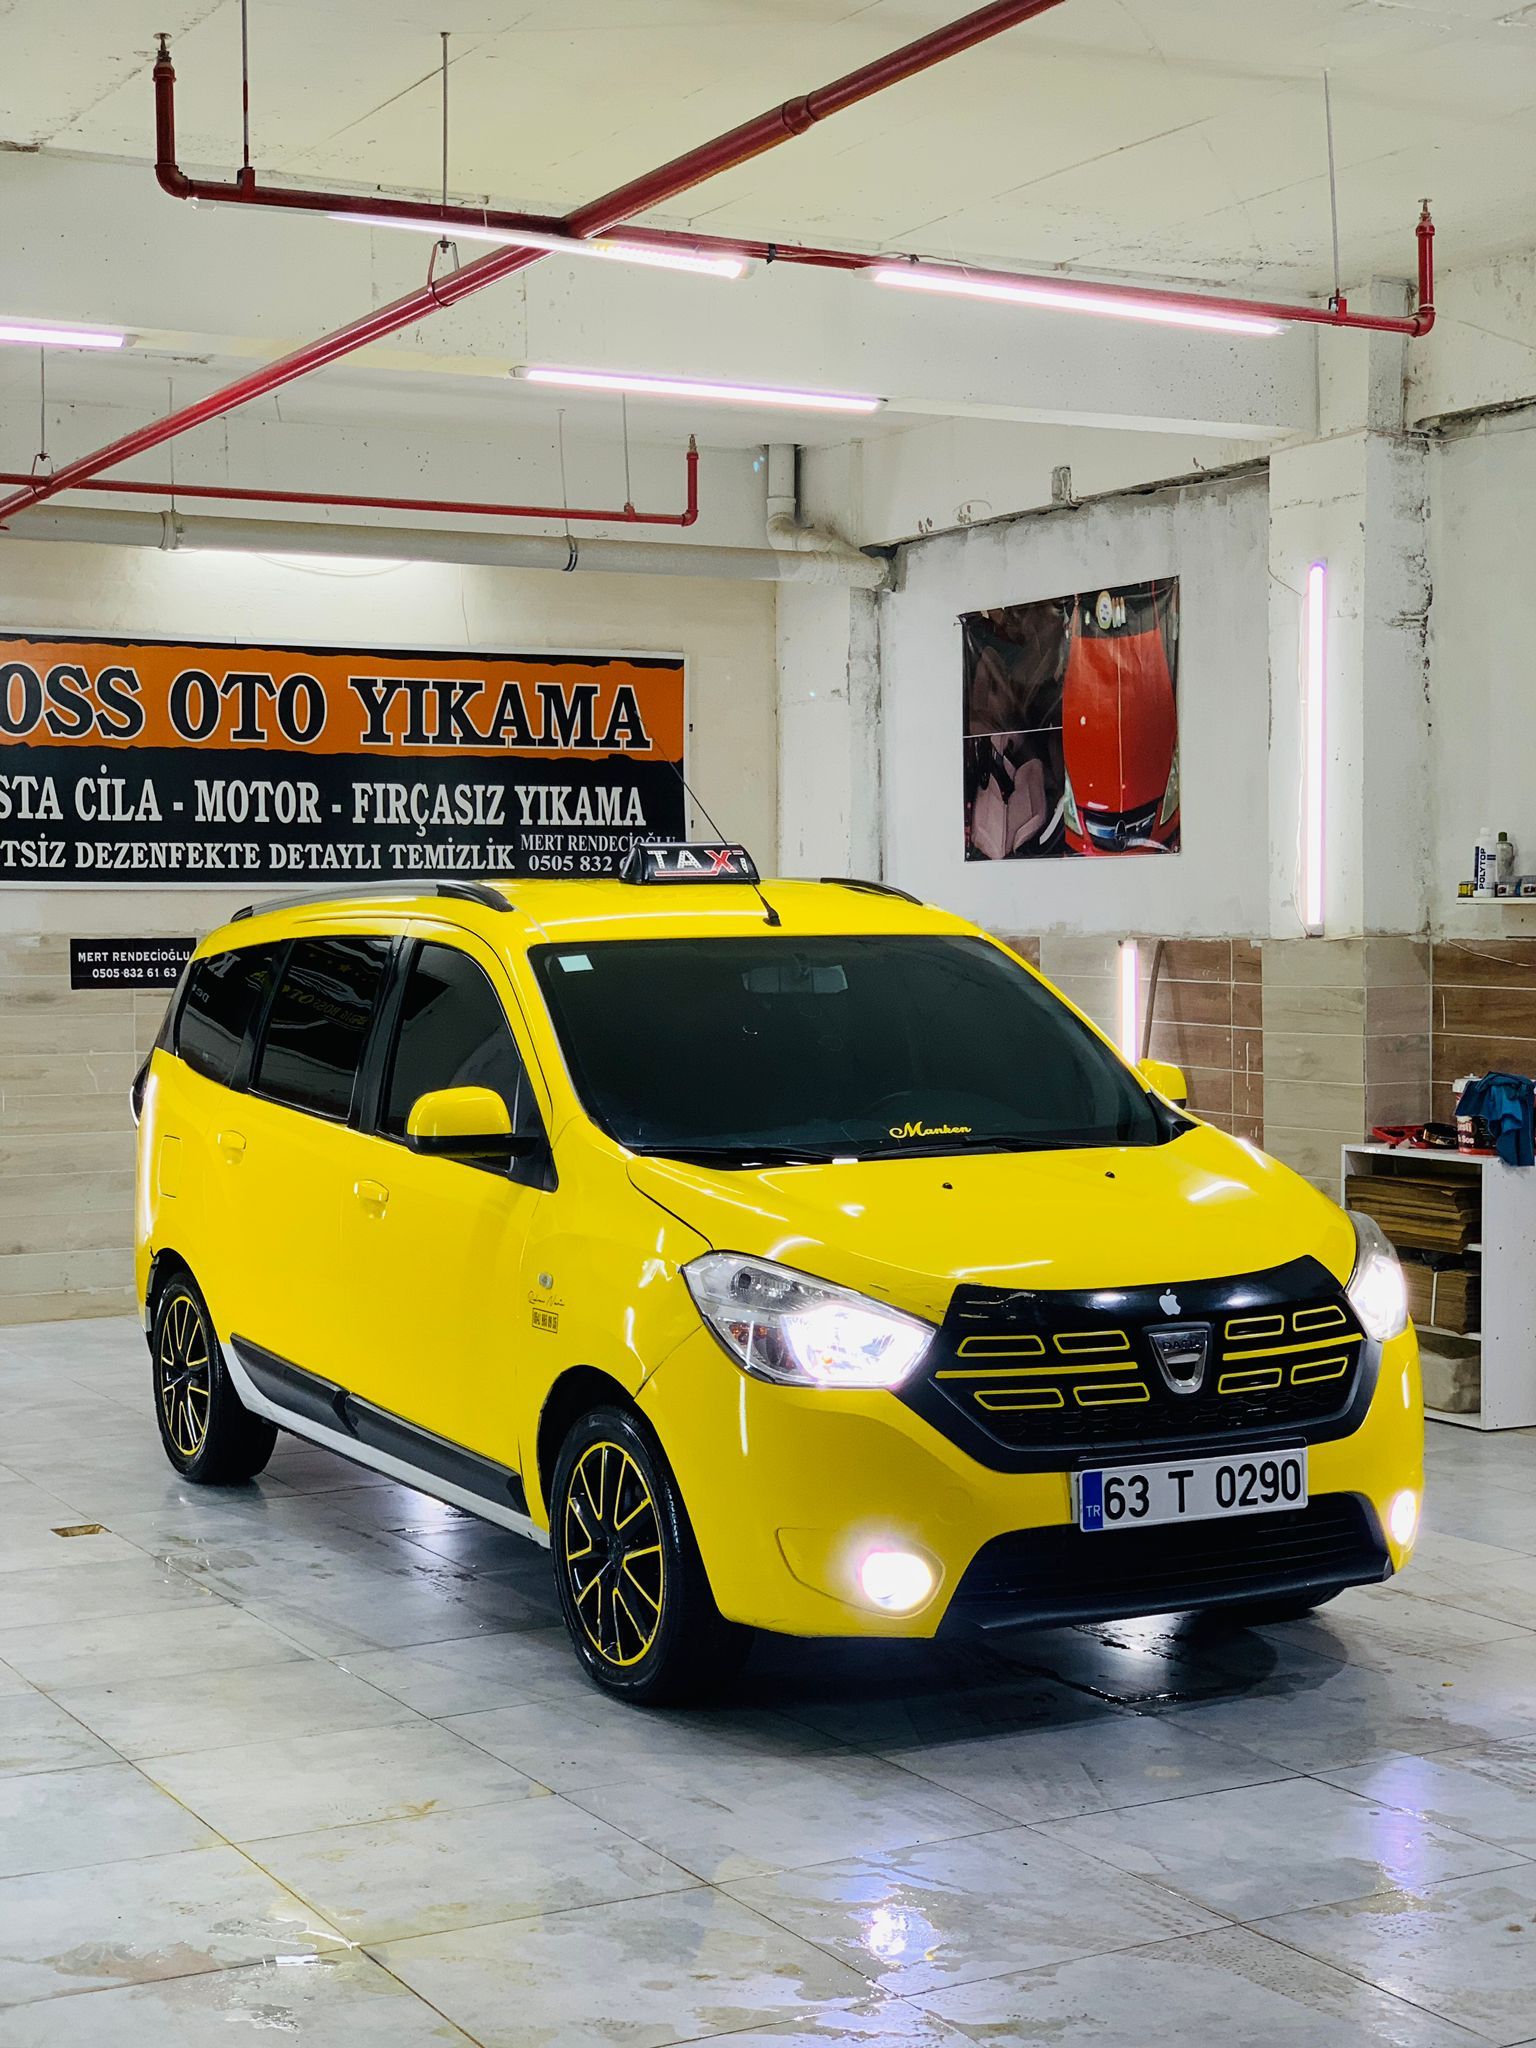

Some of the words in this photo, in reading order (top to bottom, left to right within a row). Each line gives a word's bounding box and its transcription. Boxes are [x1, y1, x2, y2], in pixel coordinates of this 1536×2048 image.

[168, 668, 327, 744] OTO
[348, 676, 652, 751] YIKAMA
[75, 764, 162, 821] CİLA
[194, 780, 322, 823] MOTOR
[352, 783, 505, 837] FIRÇASIZ
[514, 786, 647, 826] YIKAMA
[521, 834, 564, 851] MERT
[75, 842, 260, 870] DEZENFEKTE
[269, 844, 381, 871] DETAYLI
[389, 837, 515, 870] TEMİZLİK
[528, 855, 574, 871] 0505
[580, 856, 613, 872] 832
[1479, 848, 1487, 890] POLYTOP
[78, 952, 109, 963] MERT
[113, 949, 190, 962] RENDECİOĞLU
[92, 969, 120, 979] 0505
[124, 968, 144, 979] 832
[147, 968, 159, 978] 61
[164, 968, 177, 978] 63
[889, 1121, 972, 1138] Manken
[1104, 1475, 1150, 1520] 63
[1168, 1470, 1194, 1513] T
[1215, 1459, 1301, 1508] 0290
[1086, 1505, 1101, 1518] TR
